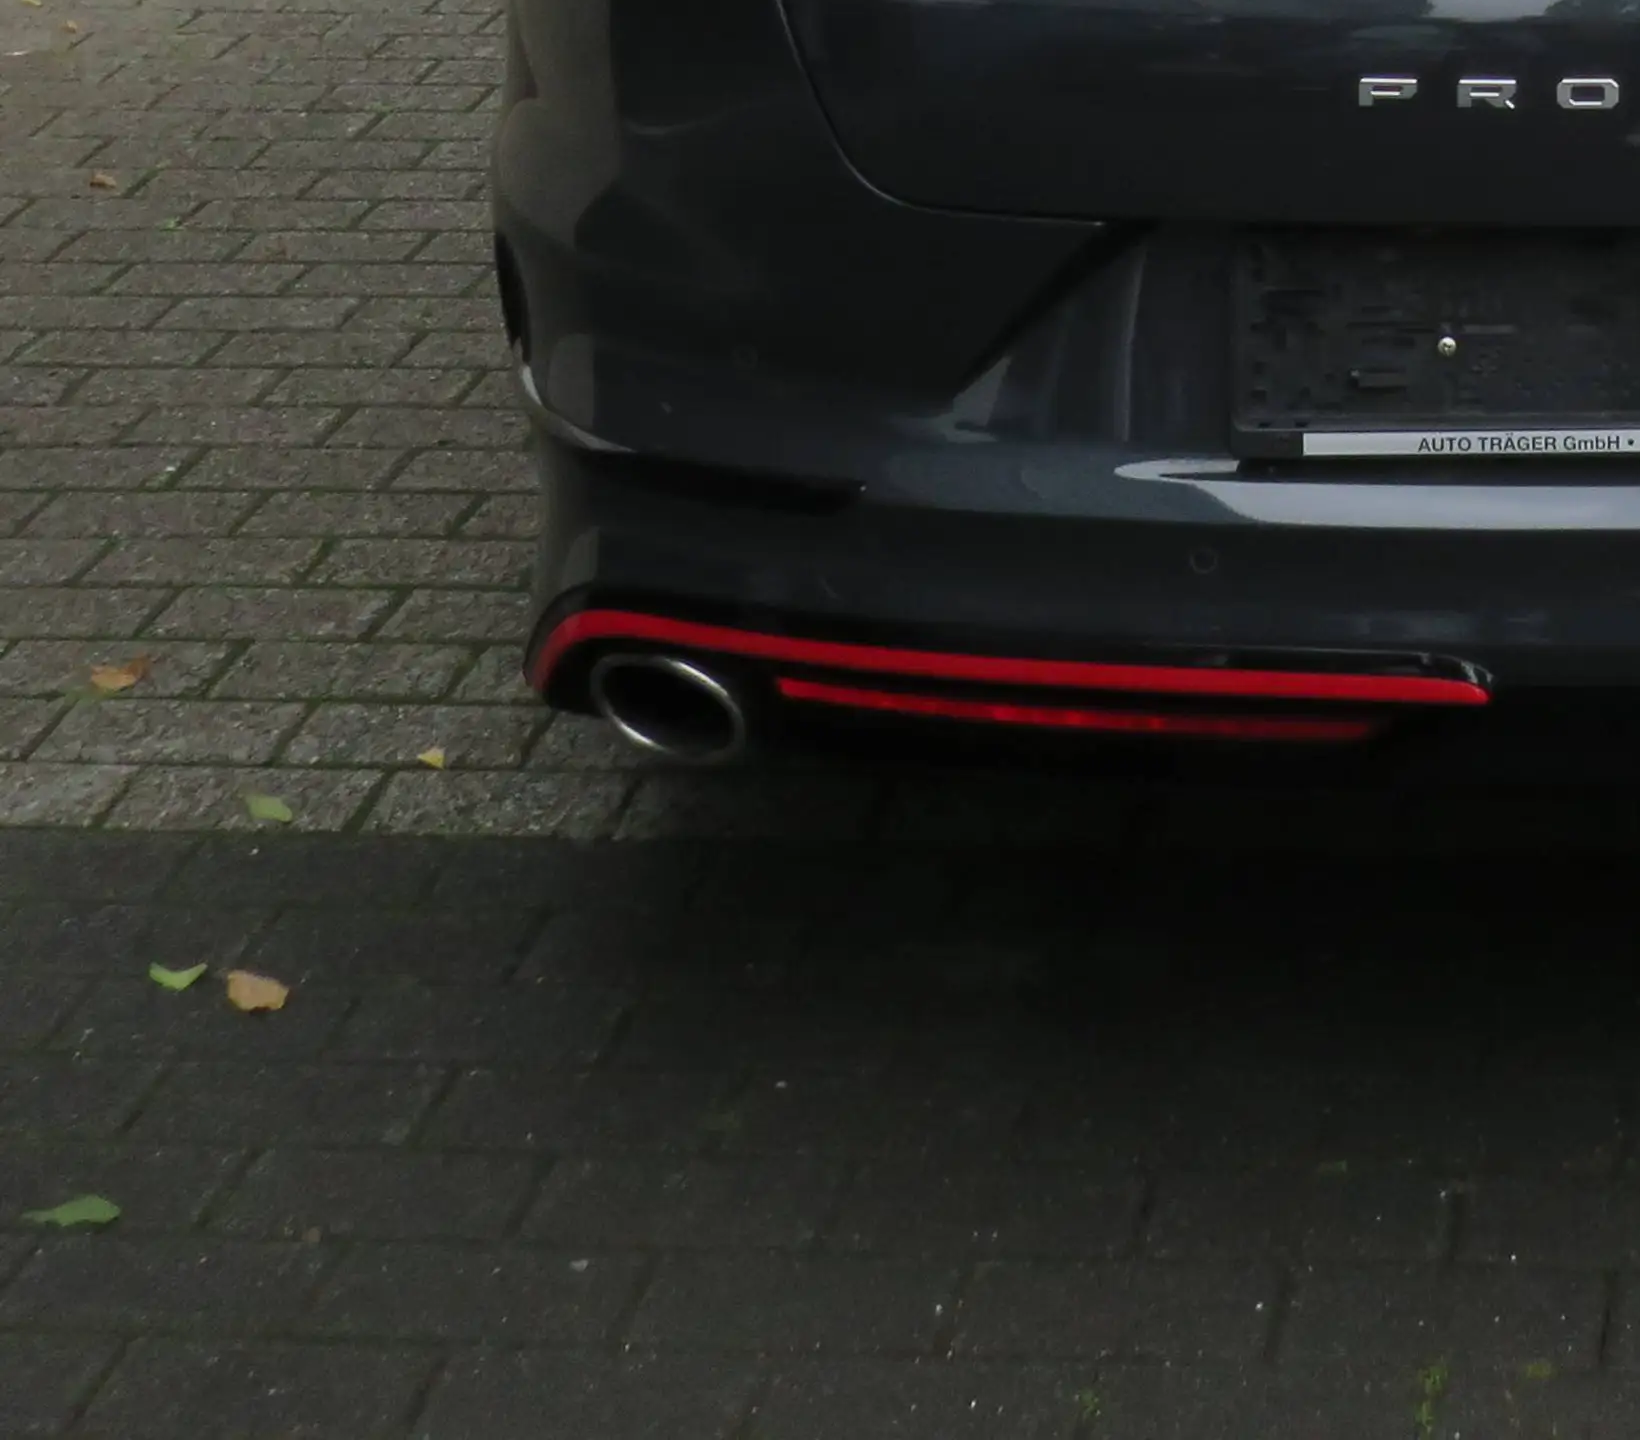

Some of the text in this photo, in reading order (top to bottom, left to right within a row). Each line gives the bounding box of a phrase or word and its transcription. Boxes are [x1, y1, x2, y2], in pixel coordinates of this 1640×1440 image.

[1418, 436, 1472, 452] AUTO
[1478, 433, 1557, 452] TRÄGER
[1563, 435, 1620, 451] GmbH
